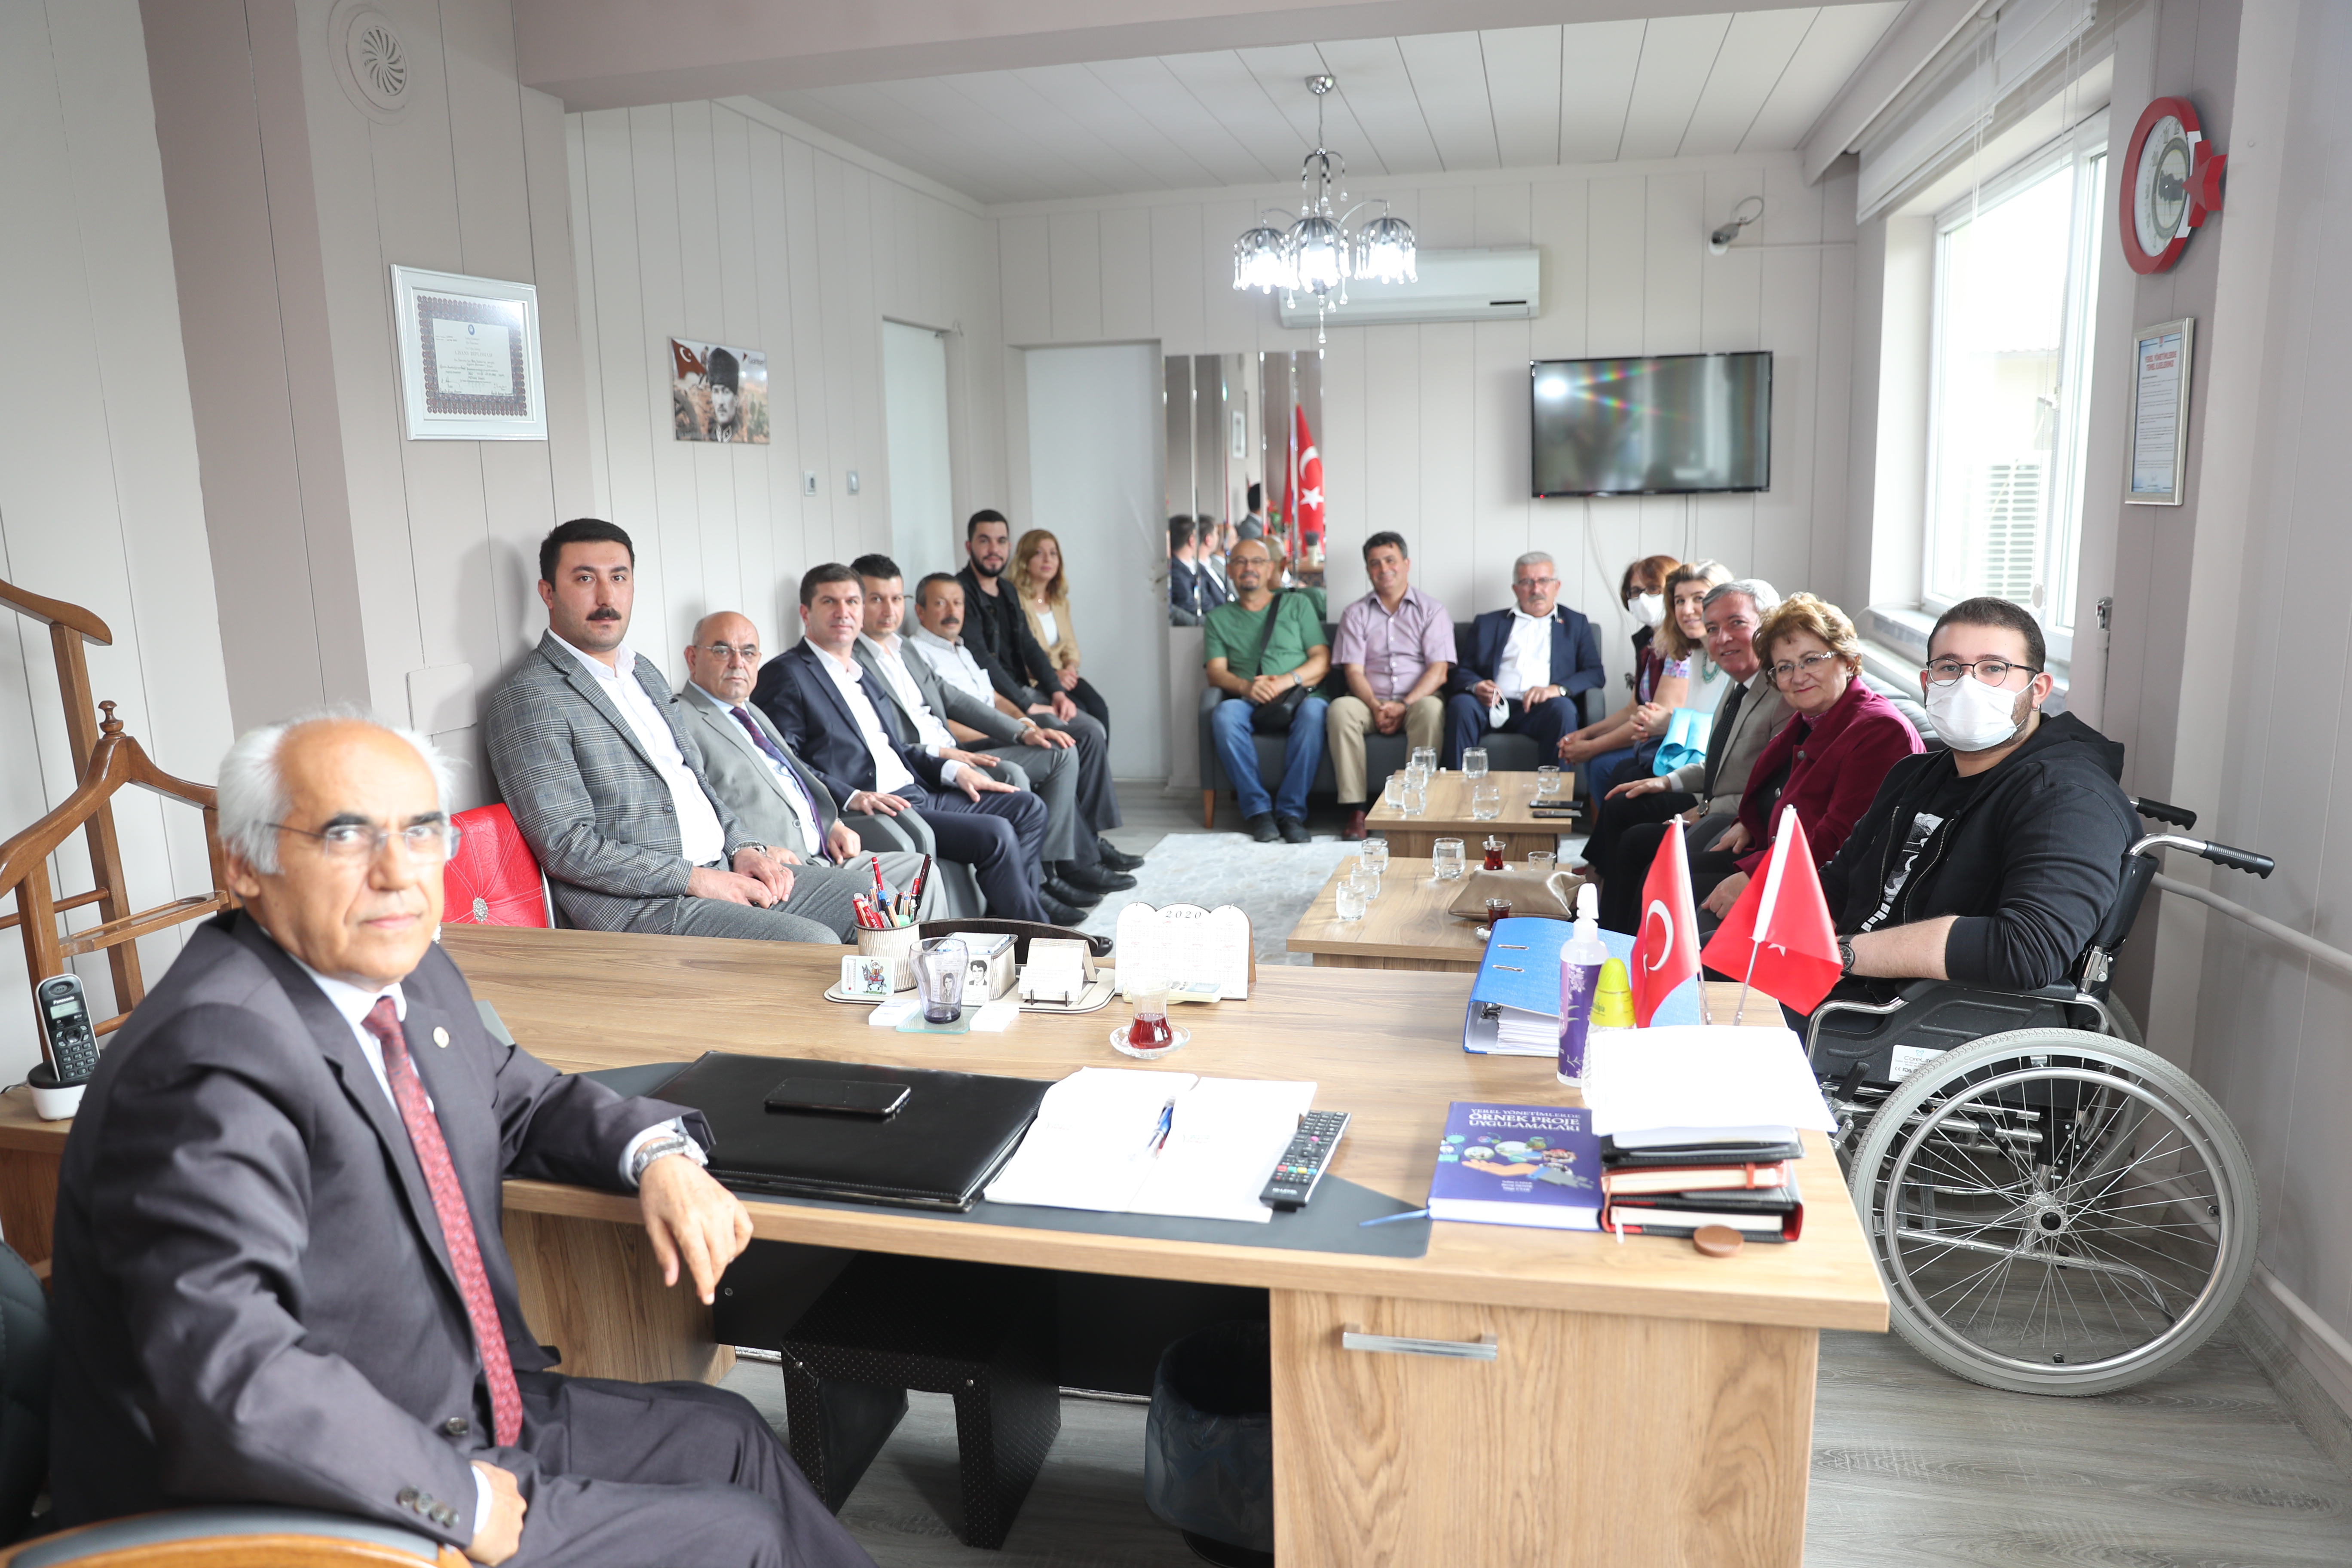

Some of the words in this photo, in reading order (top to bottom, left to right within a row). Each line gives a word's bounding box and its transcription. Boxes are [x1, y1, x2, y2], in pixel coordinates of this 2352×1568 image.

[1165, 910, 1202, 919] 2020
[53, 995, 75, 1006] Panasonic
[1468, 1112, 1528, 1122] ÖRNEK
[1531, 1116, 1580, 1125] PROJE
[1503, 1109, 1581, 1118] YÖNETİMLERDE
[1468, 1120, 1580, 1132] UYGULAMALARI
